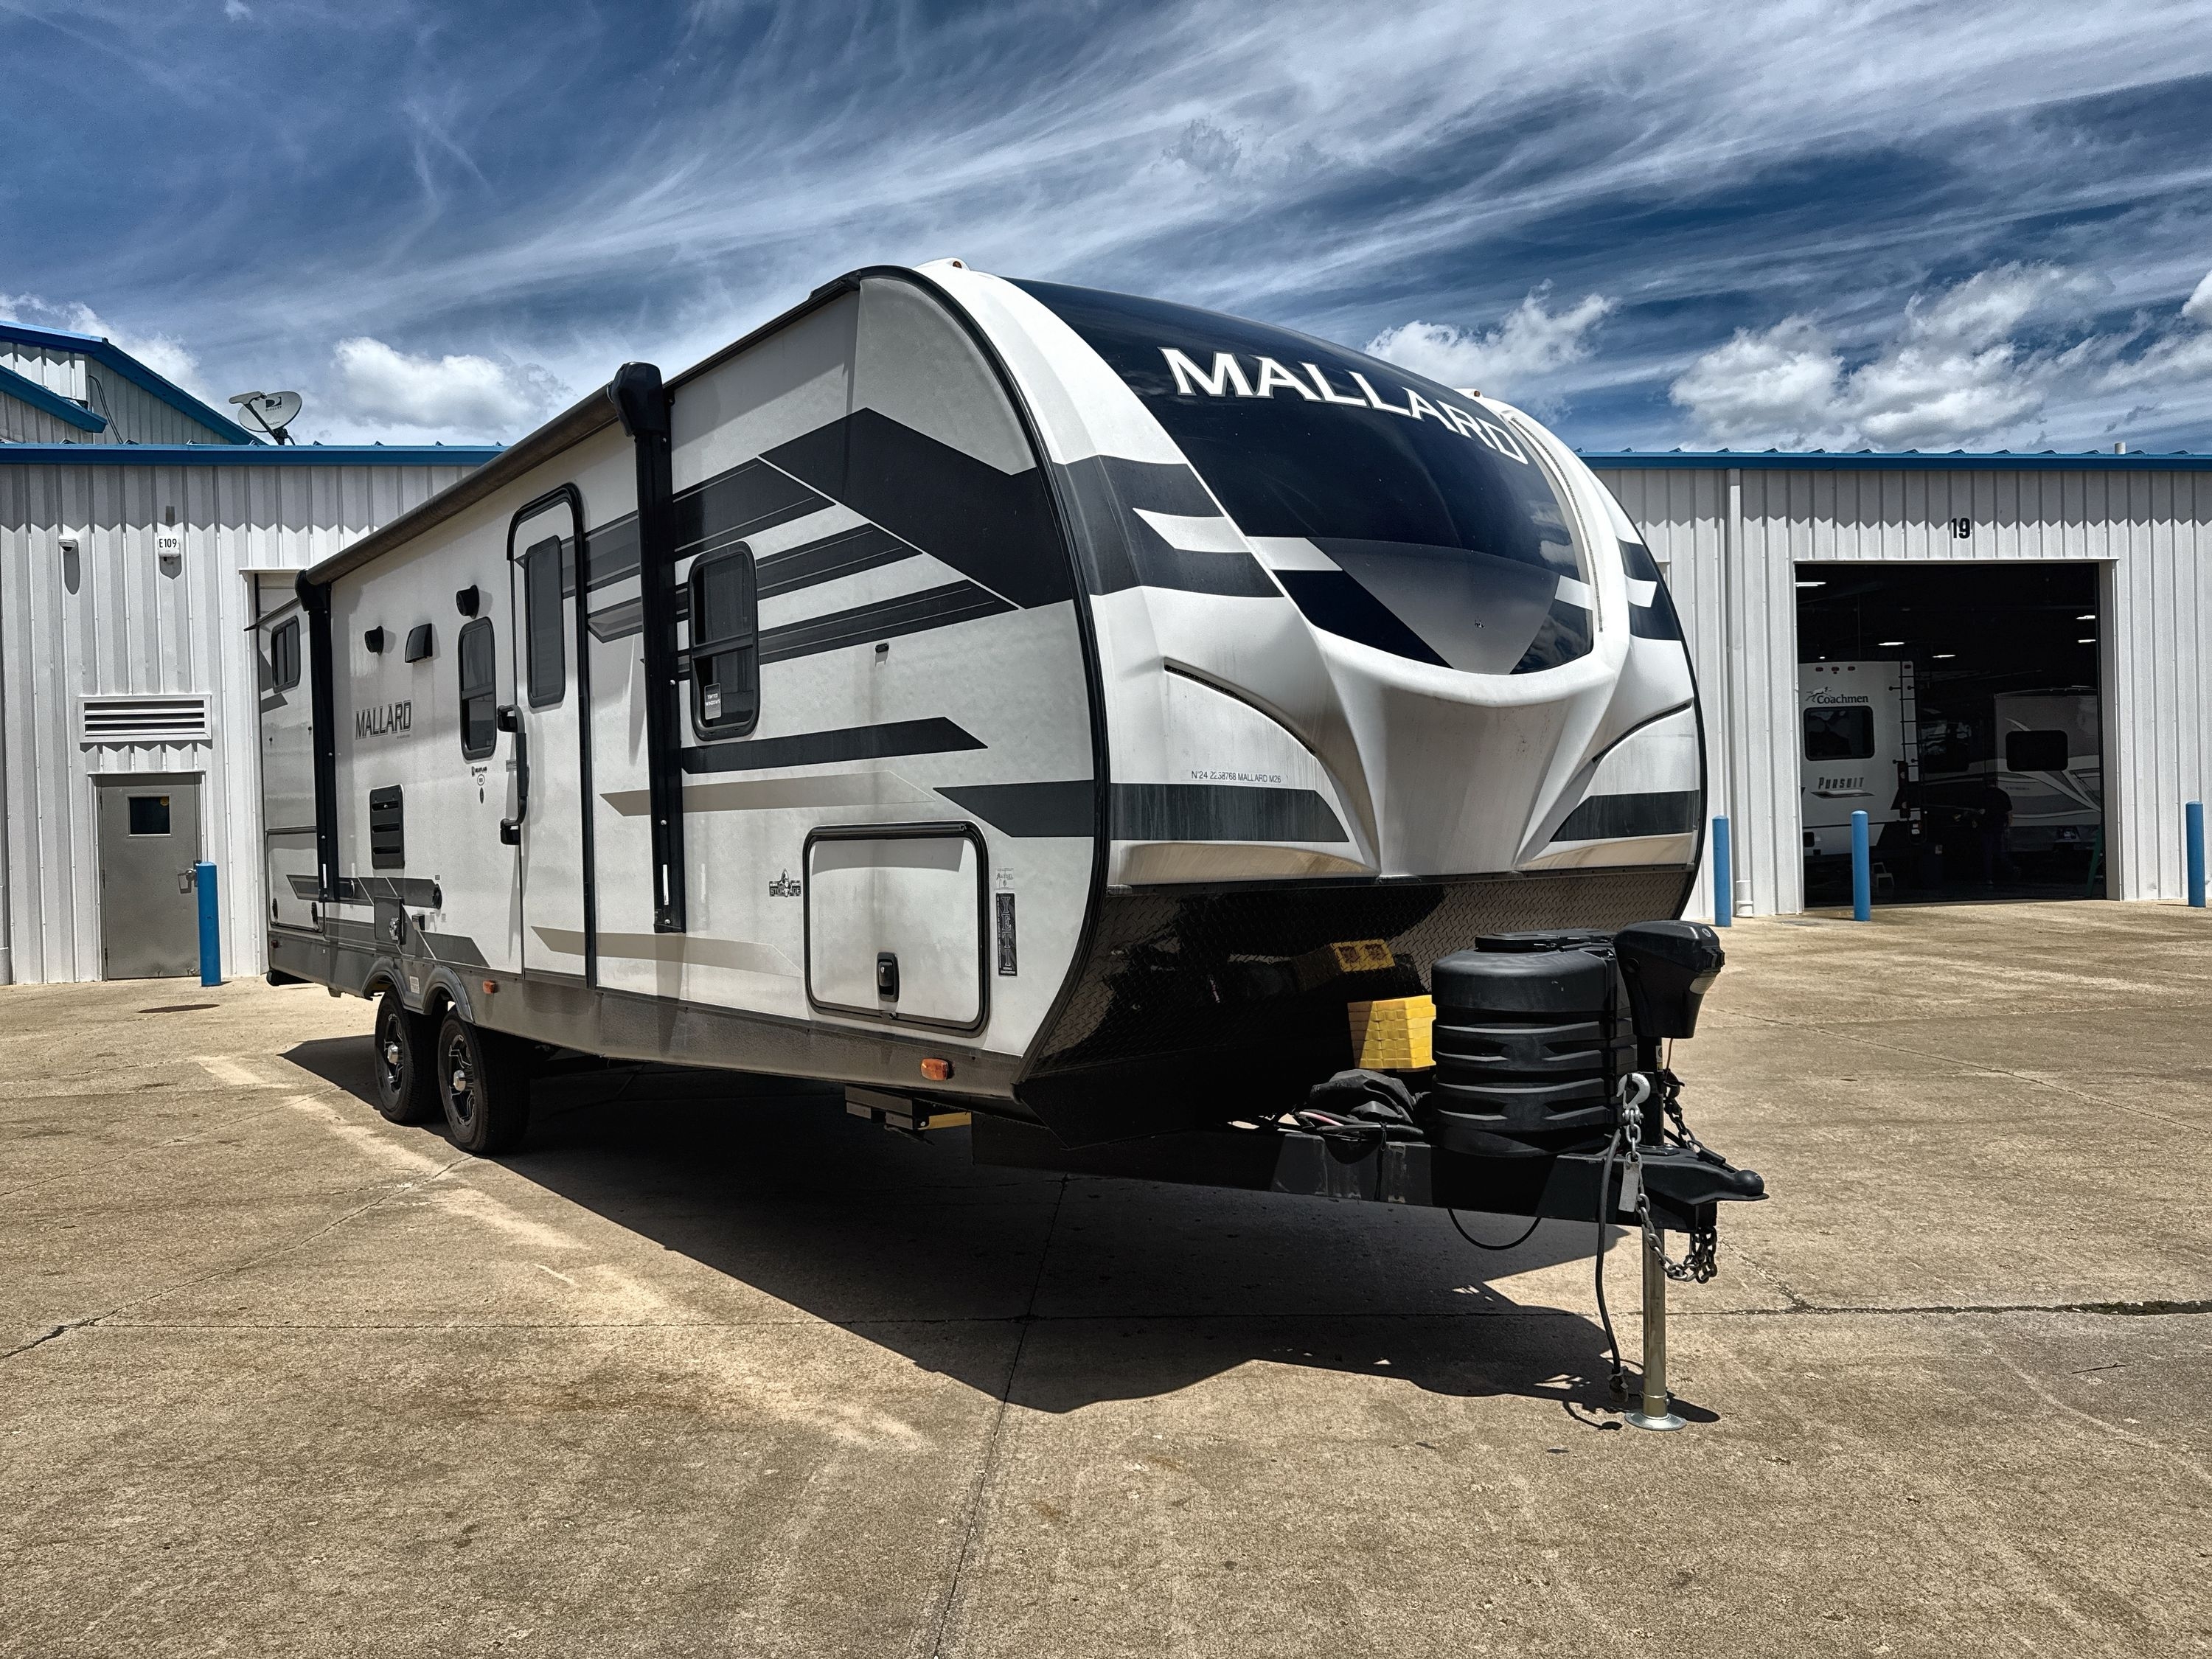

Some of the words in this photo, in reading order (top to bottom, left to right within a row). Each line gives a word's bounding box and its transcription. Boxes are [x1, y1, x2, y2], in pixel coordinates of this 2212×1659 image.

[1156, 346, 1529, 465] MALLARD
[1951, 518, 1970, 539] 19
[159, 538, 177, 548] E109
[1817, 694, 1869, 704] Coachmen
[355, 700, 411, 740] MALLARD
[1237, 773, 1267, 782] MALLARD
[1269, 775, 1281, 783] M26
[1818, 777, 1864, 789] PURSUIT
[1000, 896, 1012, 967] YETI
